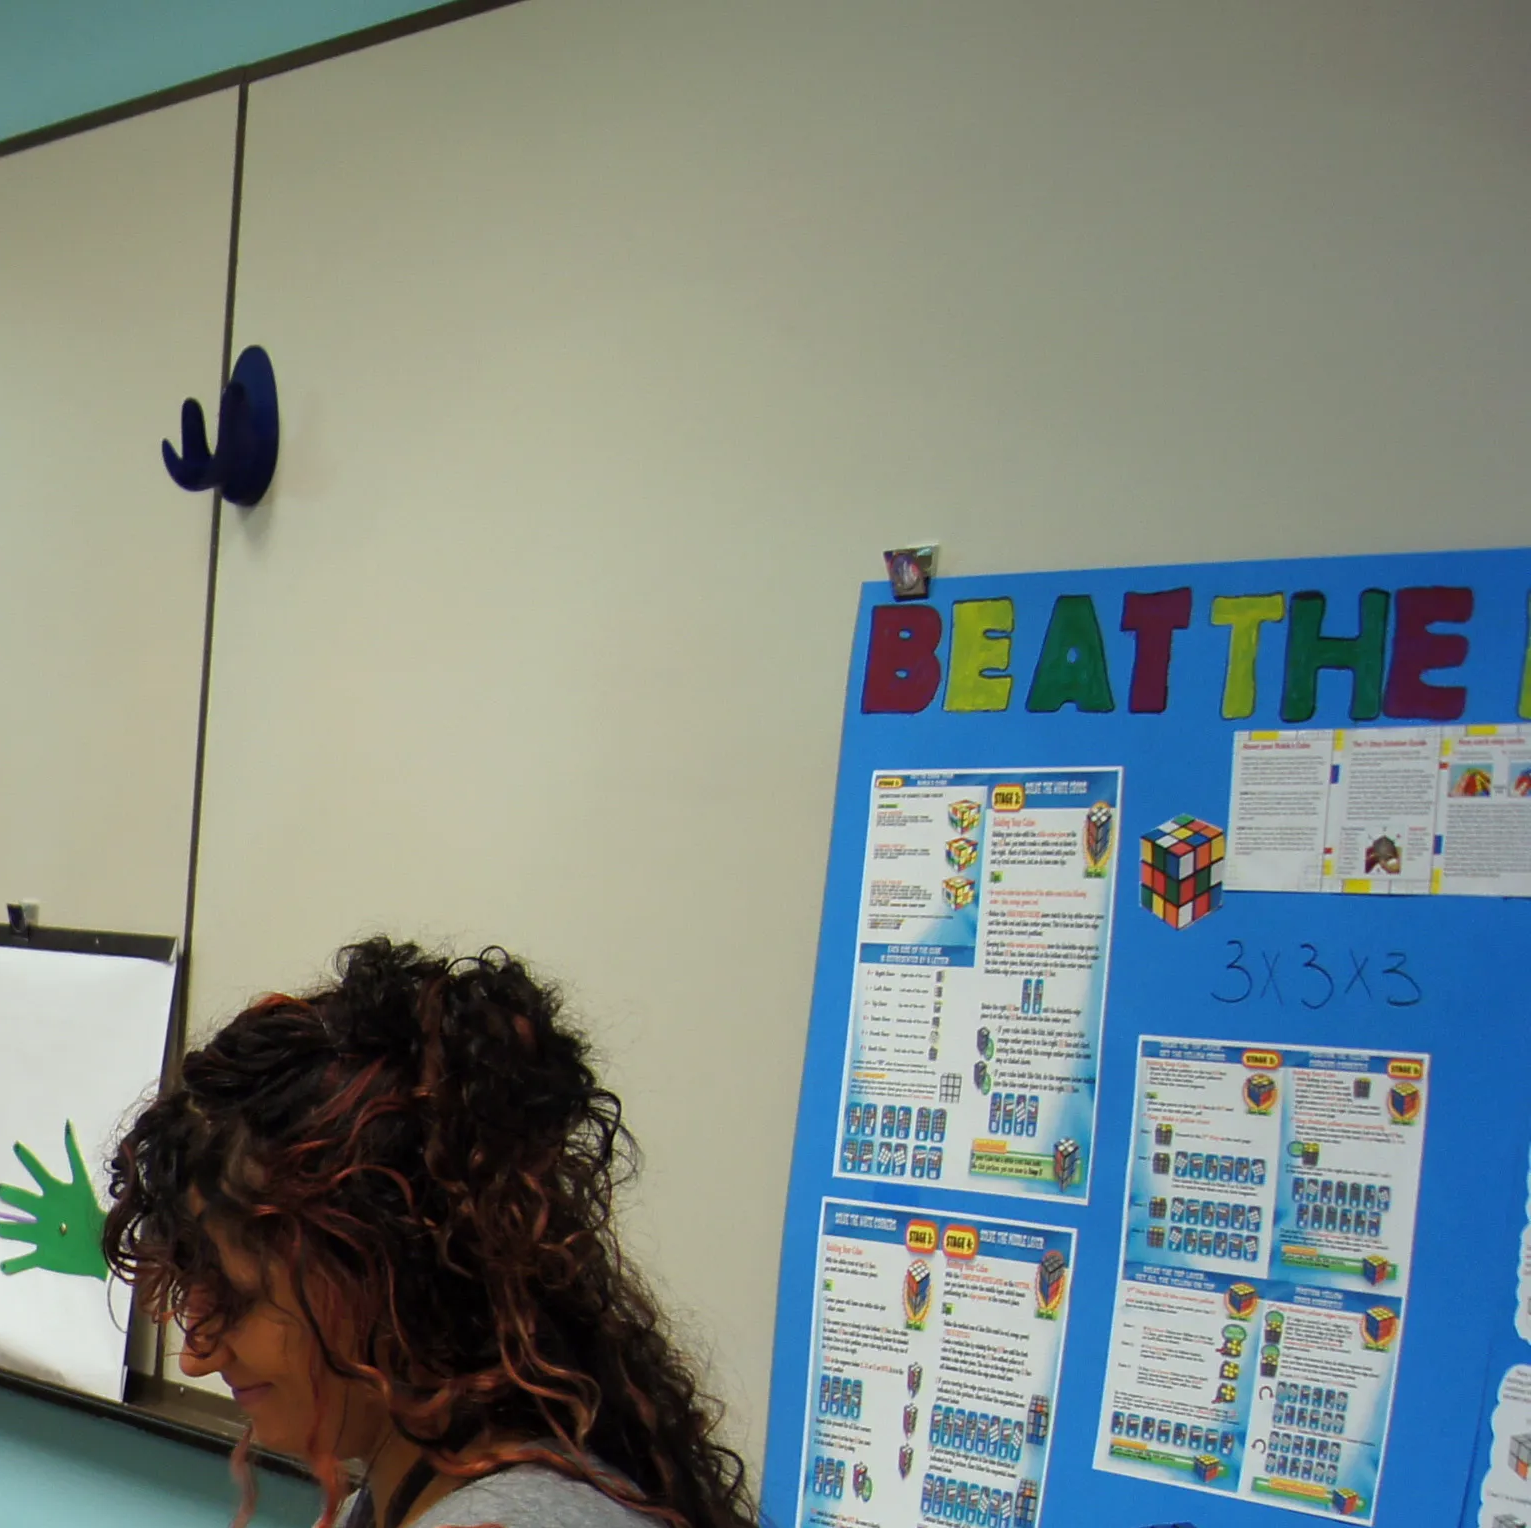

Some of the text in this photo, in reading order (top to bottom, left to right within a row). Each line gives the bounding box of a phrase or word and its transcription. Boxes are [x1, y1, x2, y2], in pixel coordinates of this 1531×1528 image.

[860, 586, 1194, 716] BEAT
[1210, 585, 1476, 722] THE
[994, 792, 1012, 805] STAGE
[1246, 1055, 1268, 1064] STAGE
[1391, 1065, 1412, 1075] STAGE
[909, 1230, 926, 1243] STAGE
[946, 1234, 965, 1248] STAGE
